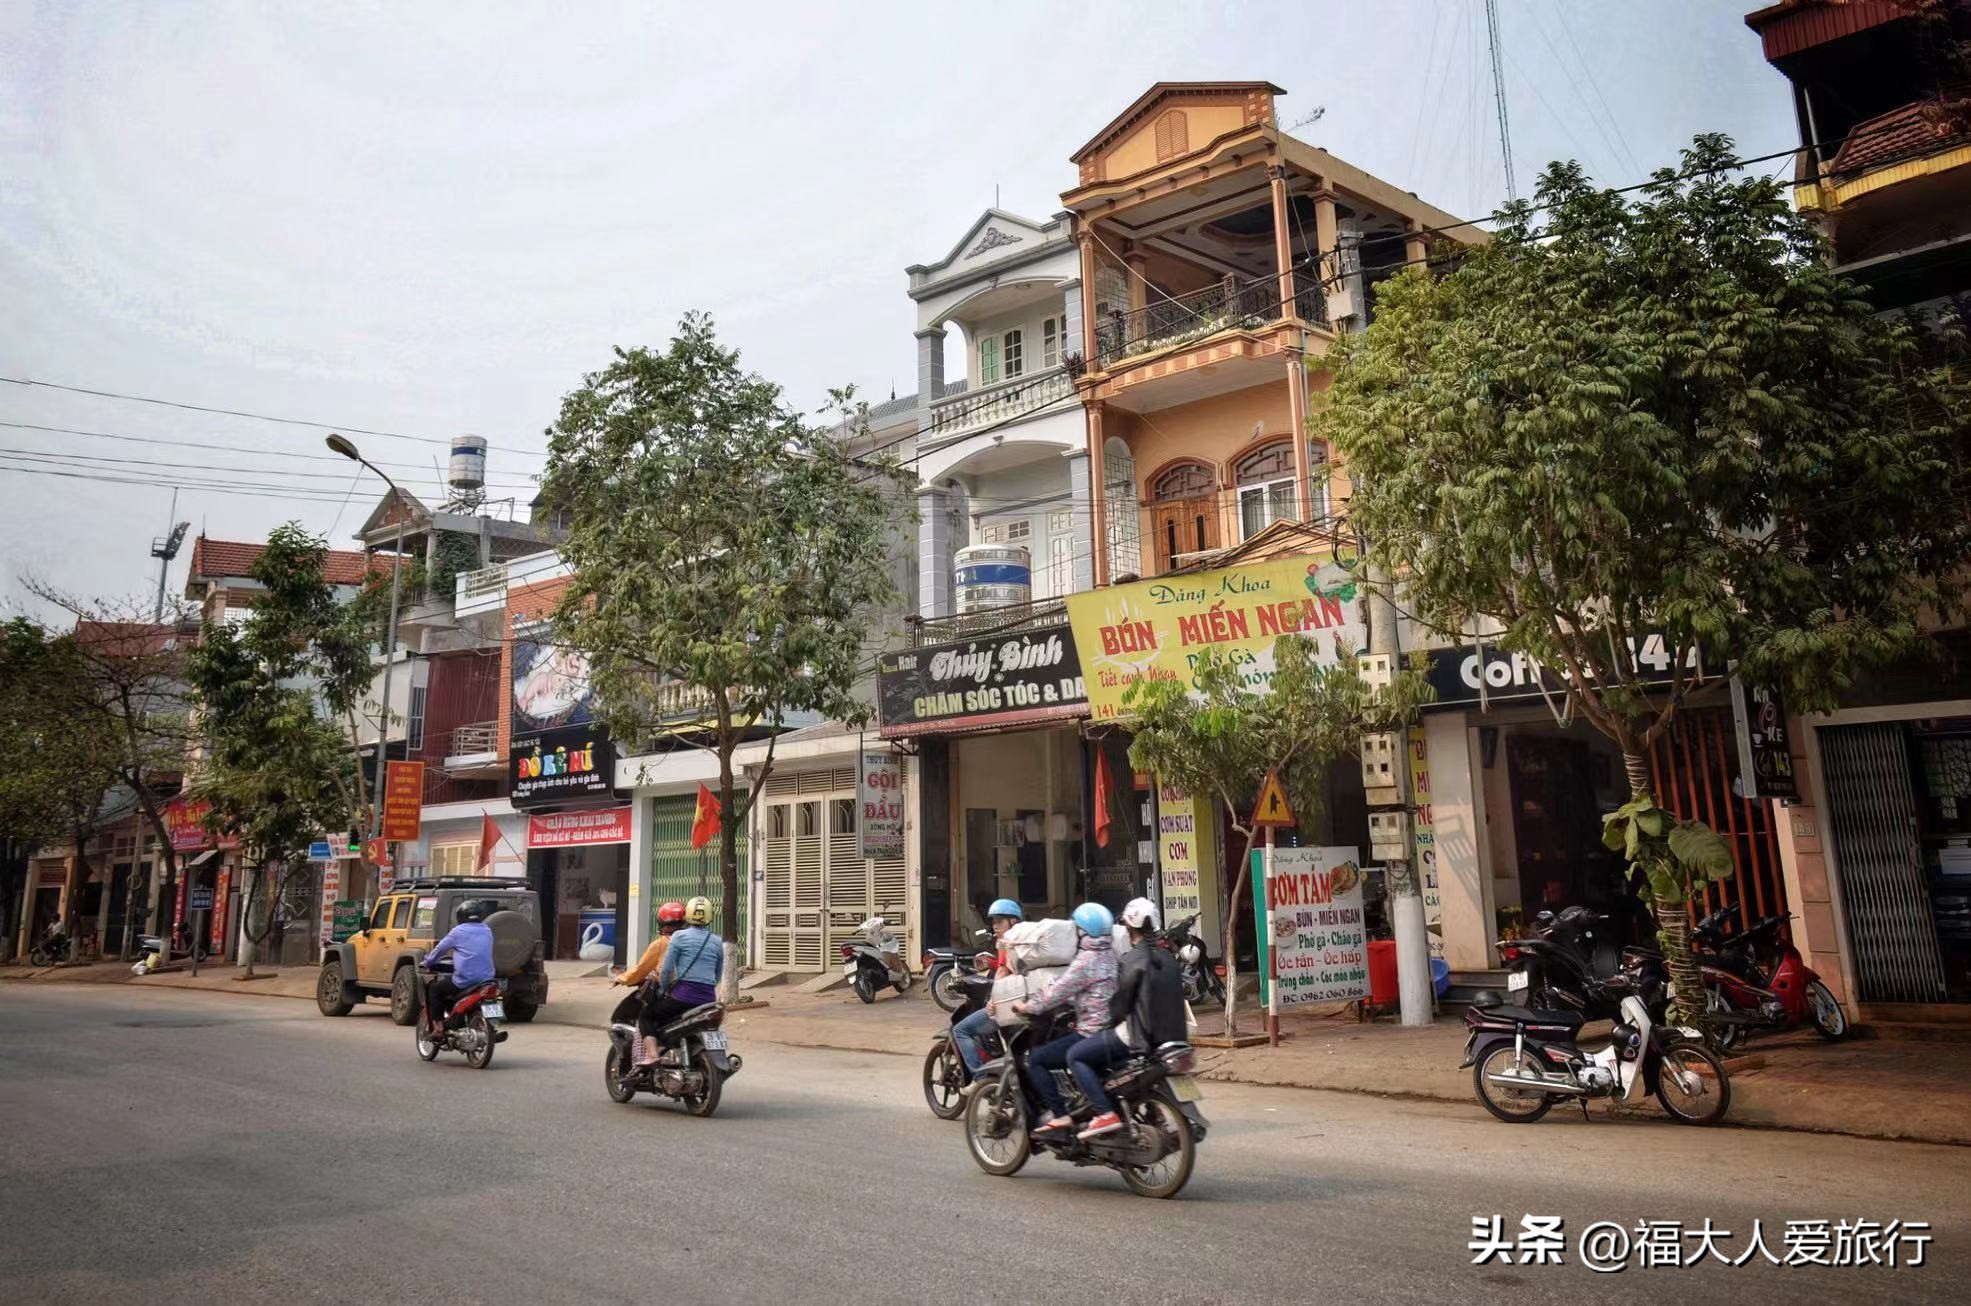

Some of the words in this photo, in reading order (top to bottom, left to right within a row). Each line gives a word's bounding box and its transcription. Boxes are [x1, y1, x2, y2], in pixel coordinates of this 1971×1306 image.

[1214, 572, 1271, 598] Khoa
[1099, 615, 1158, 656] BÚN
[1177, 599, 1250, 647] MIẾN
[999, 634, 1063, 672] Bình
[1186, 647, 1223, 671] Pở
[913, 690, 964, 718] CHĂM
[966, 684, 1001, 712] SÓC
[1003, 680, 1040, 707] TÓC
[1043, 683, 1059, 702] &
[1096, 703, 1115, 718] 141
[867, 767, 898, 792] GỘI
[1339, 908, 1361, 925] NGAN
[1331, 930, 1351, 946] Cháo
[1326, 989, 1346, 999] 060
